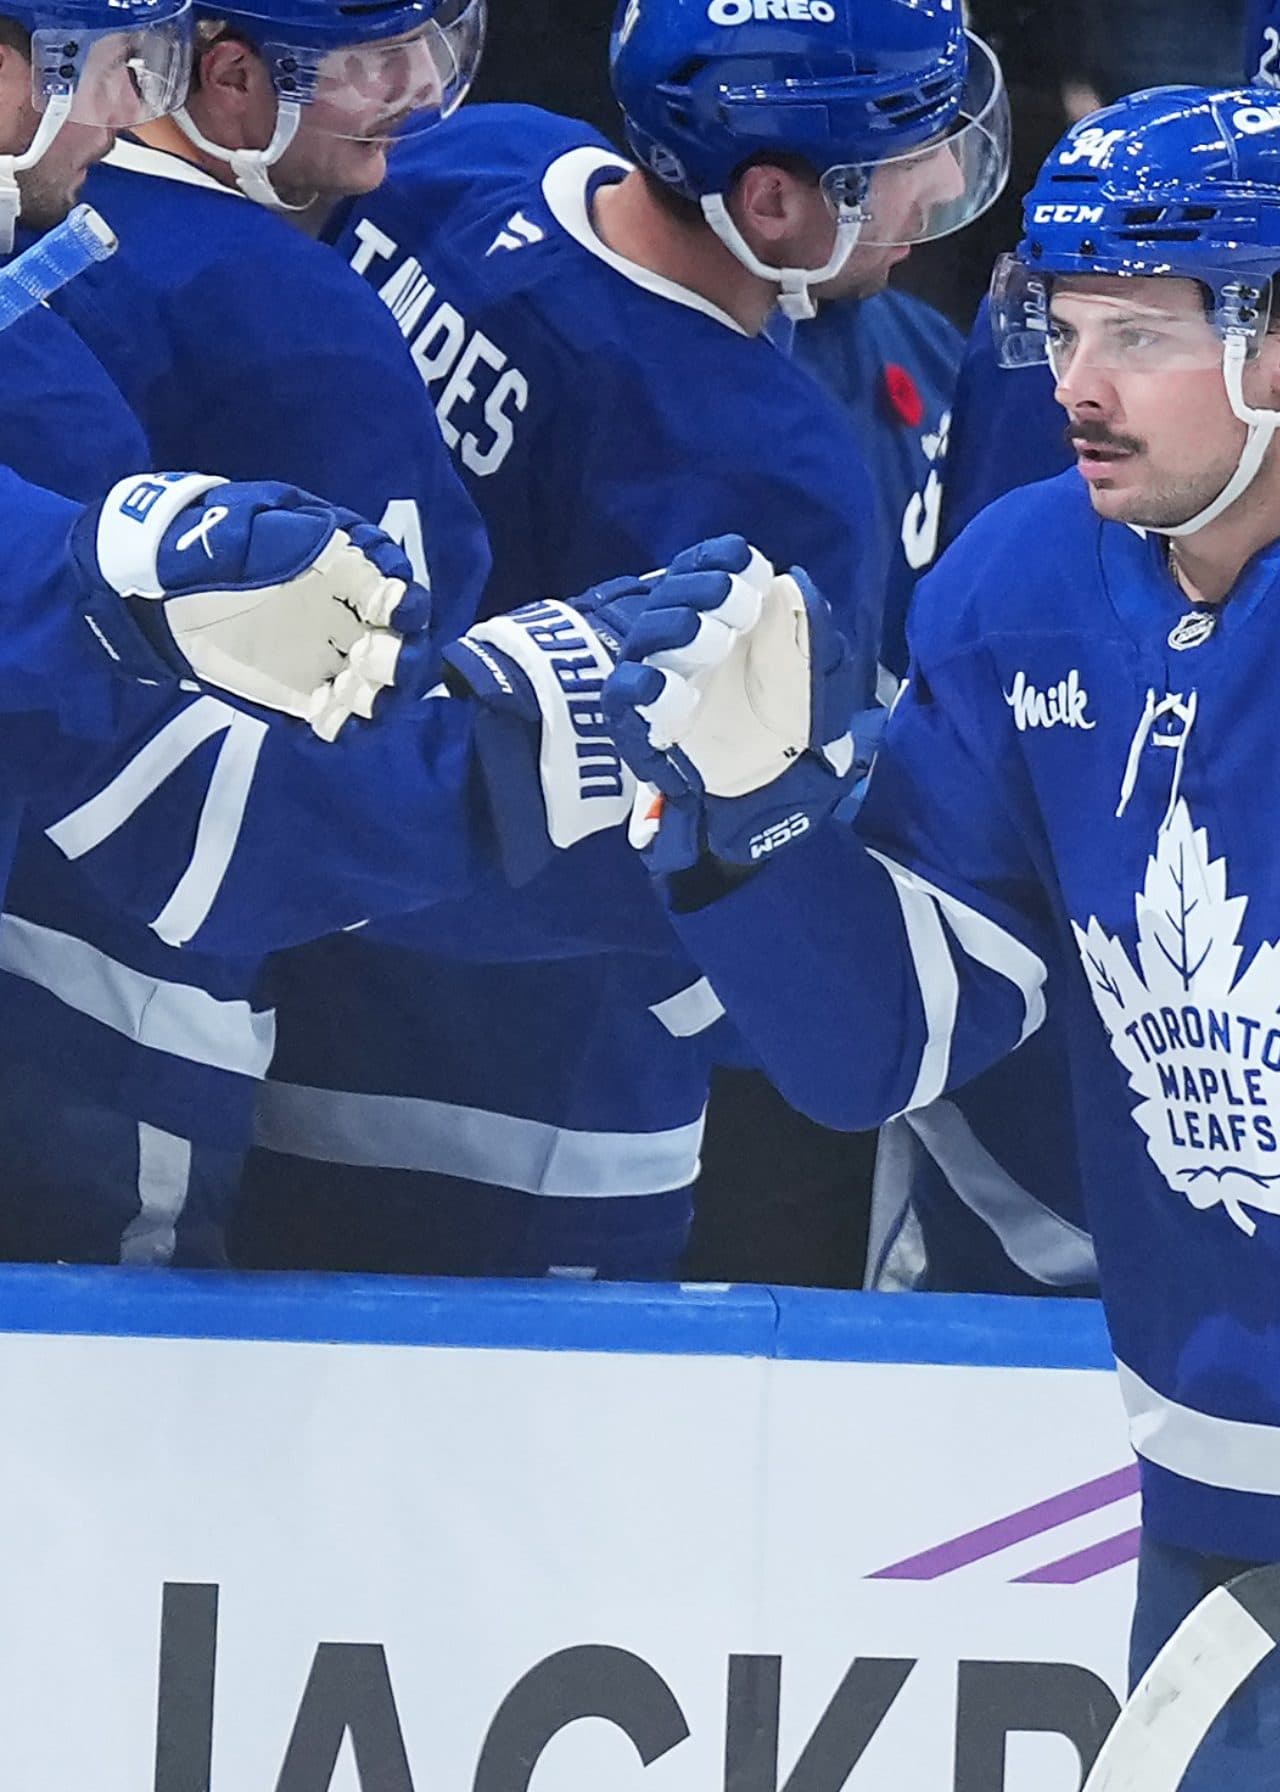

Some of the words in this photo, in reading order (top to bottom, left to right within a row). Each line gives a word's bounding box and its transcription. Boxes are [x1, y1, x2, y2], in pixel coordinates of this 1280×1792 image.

[707, 0, 836, 27] OREO
[1059, 127, 1128, 170] 34
[1032, 204, 1105, 224] CCM
[500, 599, 623, 800] WARRI
[1002, 668, 1097, 732] Milk
[750, 816, 810, 859] CCM
[1156, 1062, 1268, 1106] MAPLE
[1166, 1108, 1278, 1153] LEAFS
